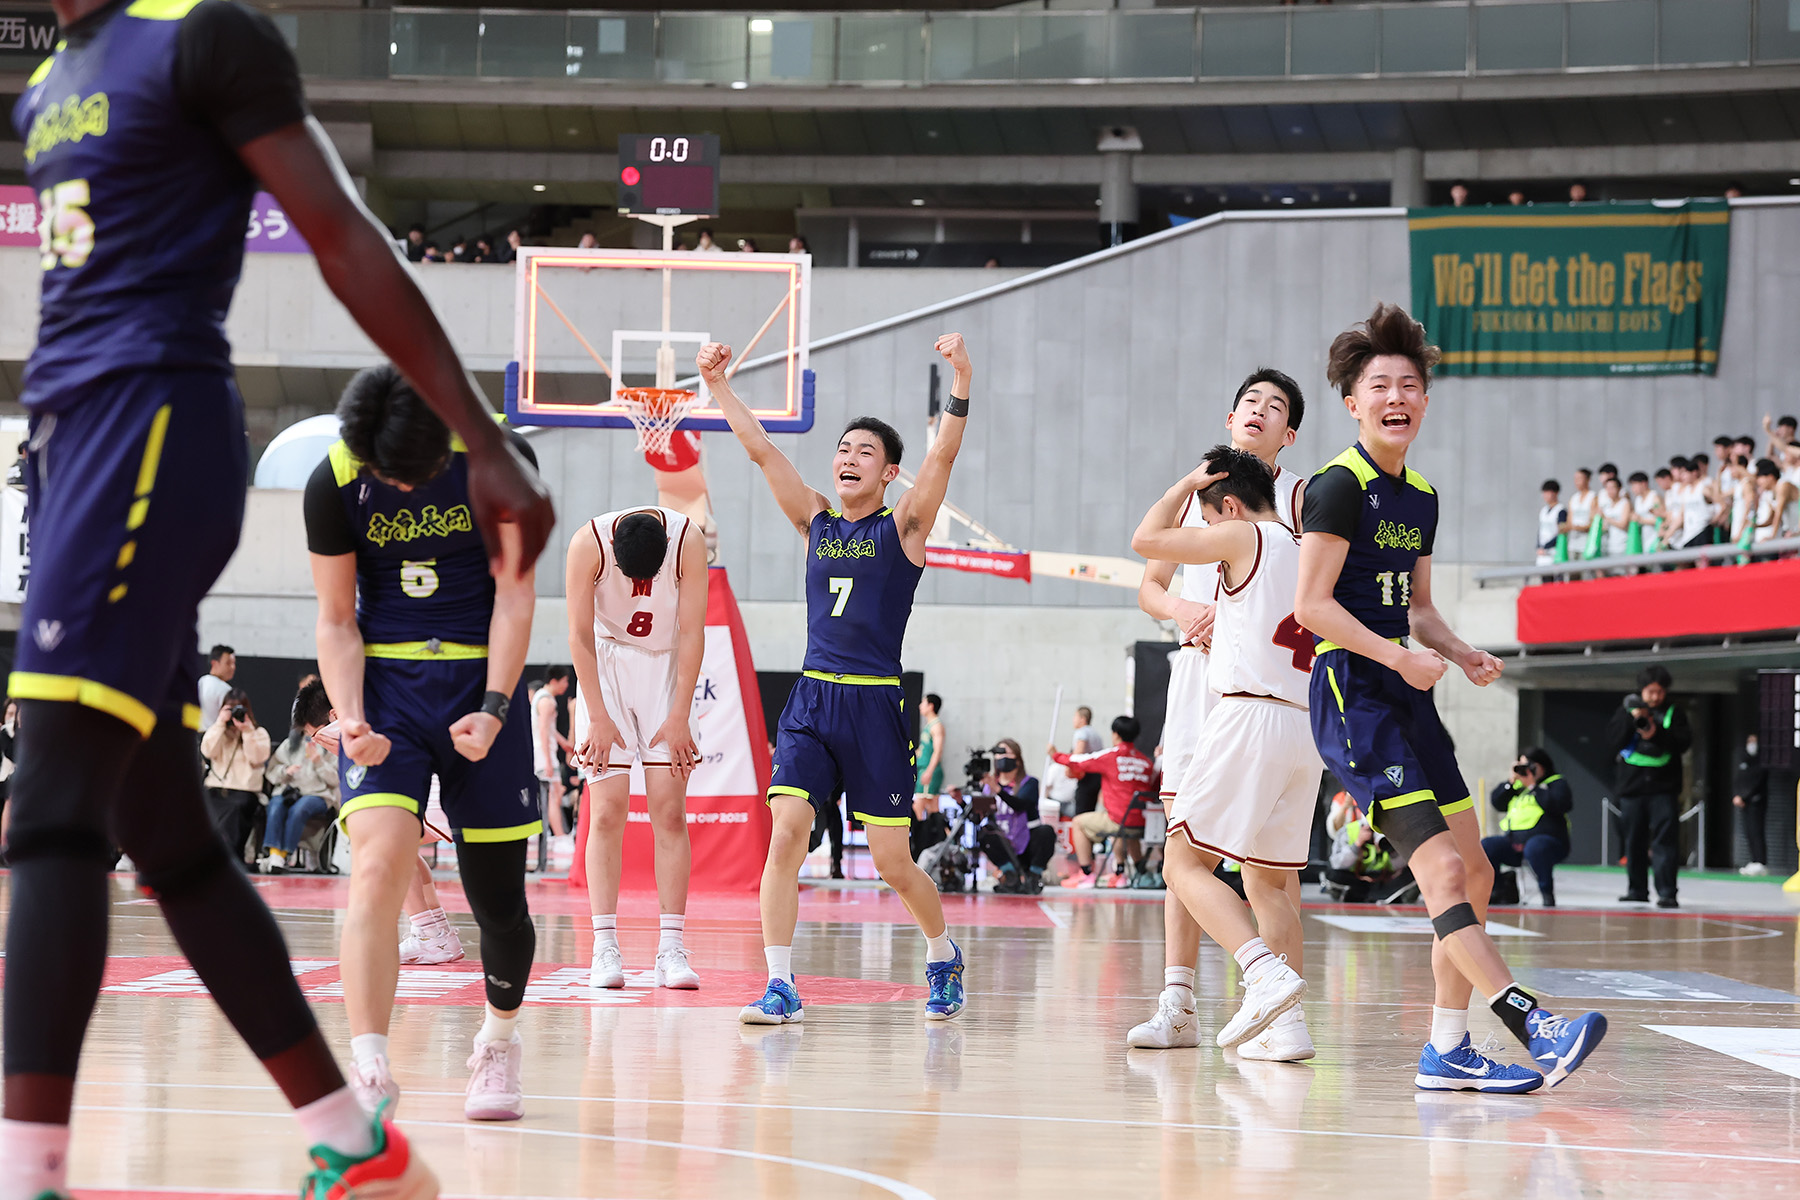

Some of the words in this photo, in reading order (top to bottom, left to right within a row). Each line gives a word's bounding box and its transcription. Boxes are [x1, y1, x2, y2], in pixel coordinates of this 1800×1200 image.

[649, 137, 689, 162] 0.0
[0, 202, 38, 235] 援
[1433, 252, 1502, 307] We'll
[1510, 252, 1559, 307] Get
[1566, 252, 1615, 307] the
[1623, 252, 1703, 315] Flags
[1472, 310, 1547, 333] FUKUOKA
[1619, 310, 1662, 333] BOYS
[400, 557, 439, 598] 5
[1375, 571, 1410, 606] 11
[829, 577, 854, 617] 7
[626, 610, 654, 637] 8
[697, 812, 718, 824] CUP
